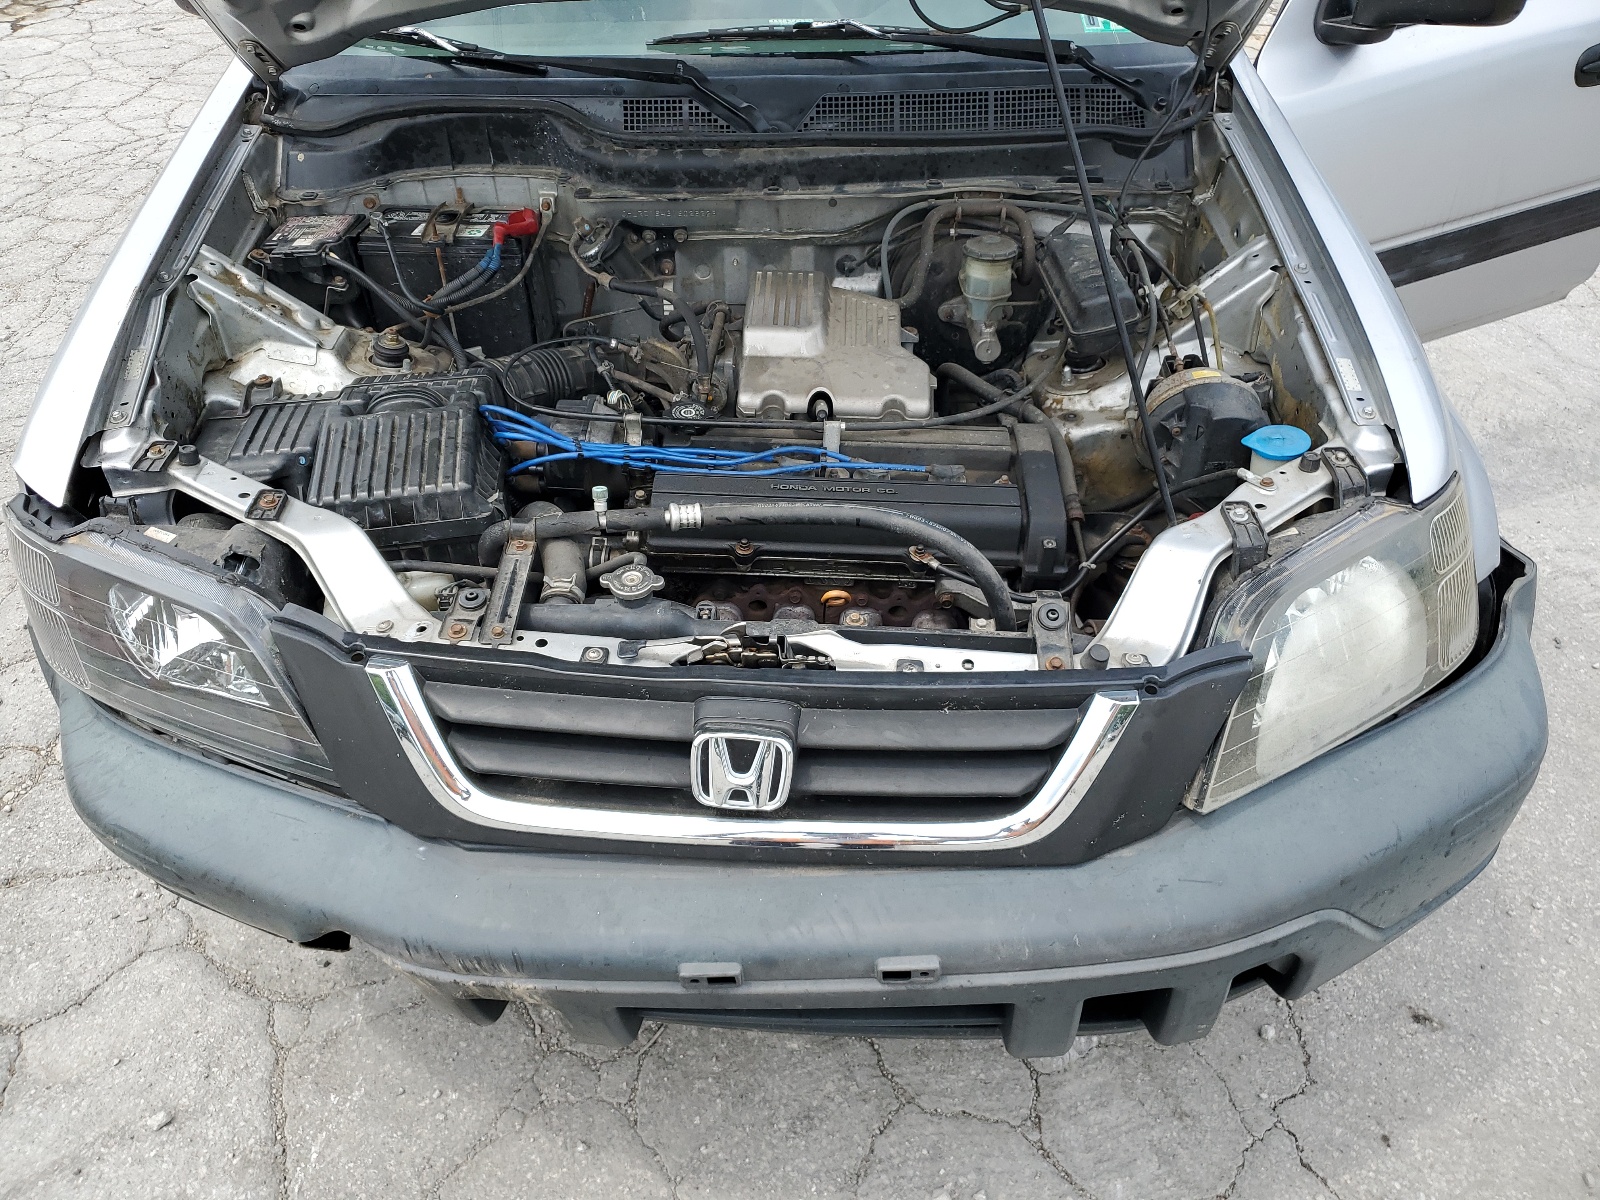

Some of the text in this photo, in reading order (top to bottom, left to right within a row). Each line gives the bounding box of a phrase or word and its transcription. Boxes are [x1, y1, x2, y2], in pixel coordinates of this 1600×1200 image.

[770, 483, 899, 495] HONDA MOTOR CO.
